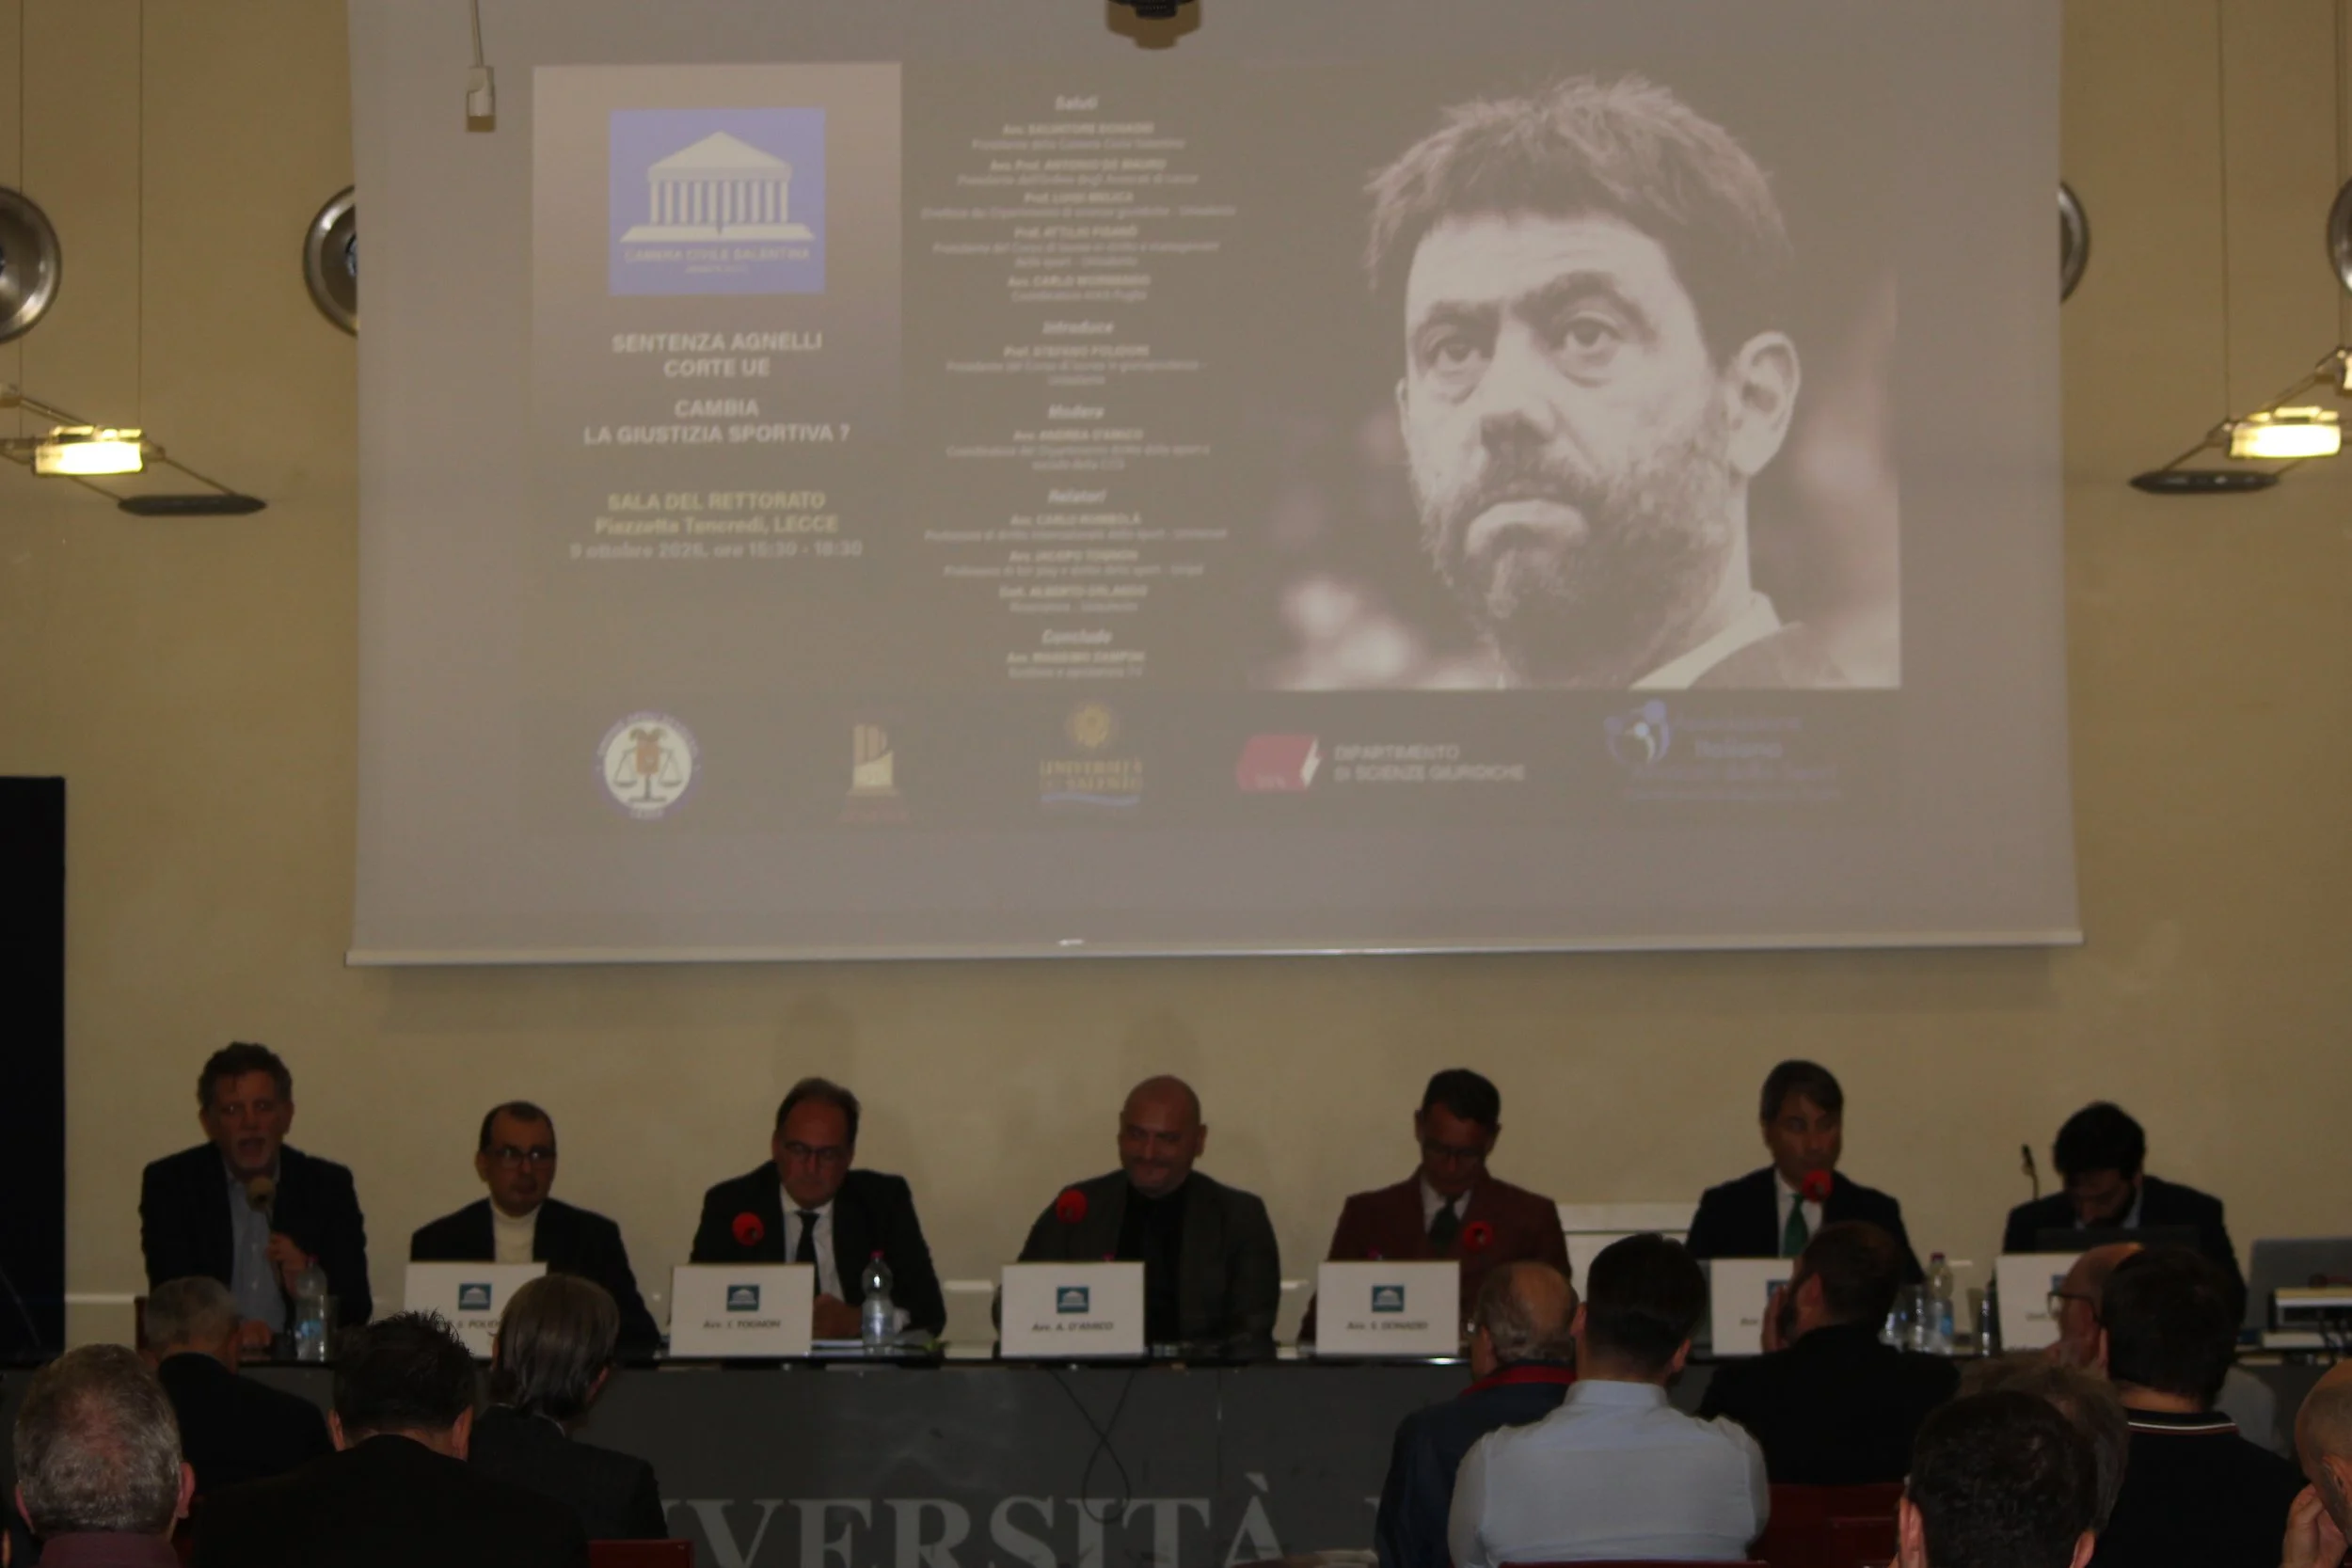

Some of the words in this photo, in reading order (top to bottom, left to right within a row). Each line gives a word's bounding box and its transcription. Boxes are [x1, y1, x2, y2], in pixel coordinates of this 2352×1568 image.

[612, 332, 725, 353] SENTENZA
[730, 331, 824, 352] AGNELLI
[662, 358, 738, 377] CORTE
[740, 357, 771, 376] UE
[674, 398, 760, 418] CAMBIA
[583, 426, 613, 446] LA
[616, 424, 723, 444] GIUSTIZIA
[727, 423, 834, 443] SPORTIVA
[608, 493, 660, 511] SALA
[664, 492, 705, 510] DEL
[708, 490, 827, 509] RETTORATO
[774, 515, 840, 532] LECCE
[661, 1473, 1283, 1568] VERSITÀ
